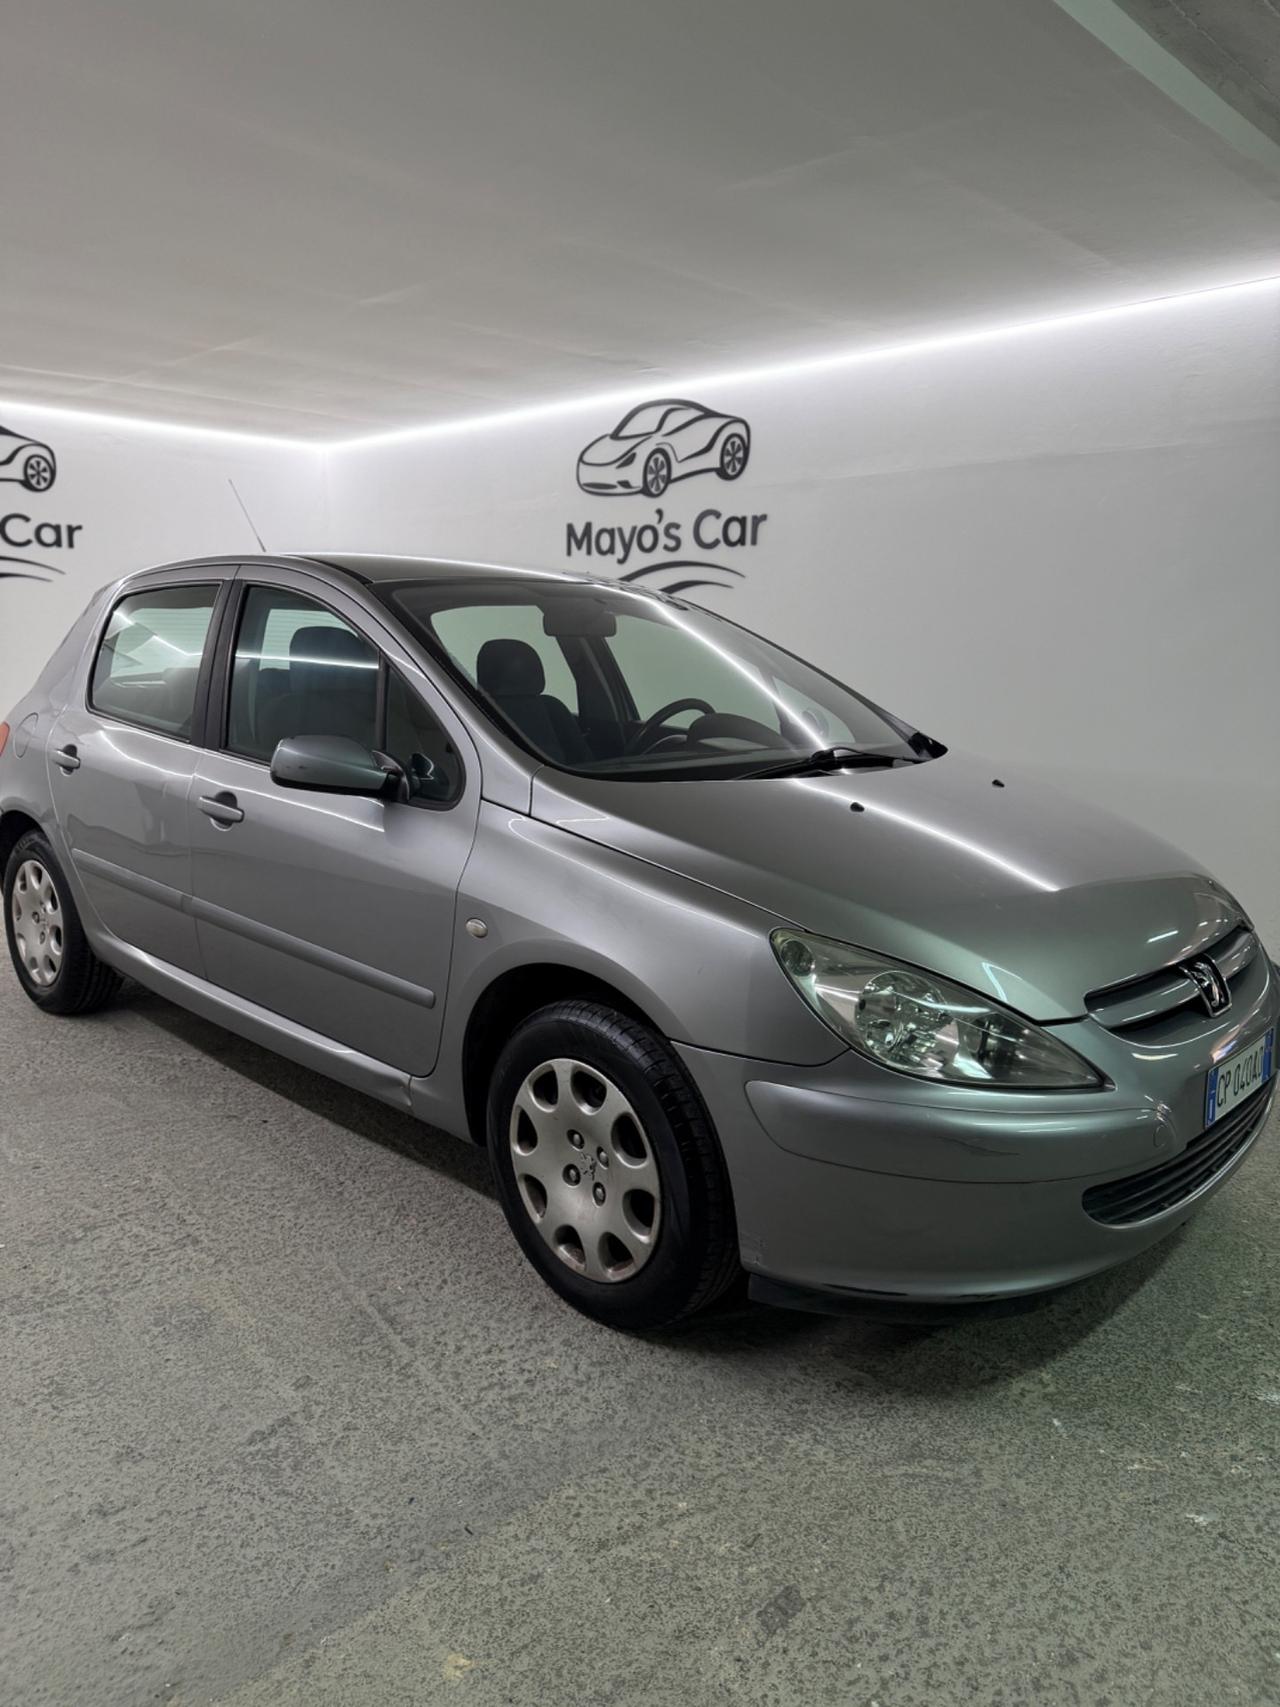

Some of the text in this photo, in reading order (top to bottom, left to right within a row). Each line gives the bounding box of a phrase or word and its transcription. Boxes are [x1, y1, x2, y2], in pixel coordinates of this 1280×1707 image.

[0, 512, 83, 549] Car
[566, 508, 768, 565] Mayo's Car
